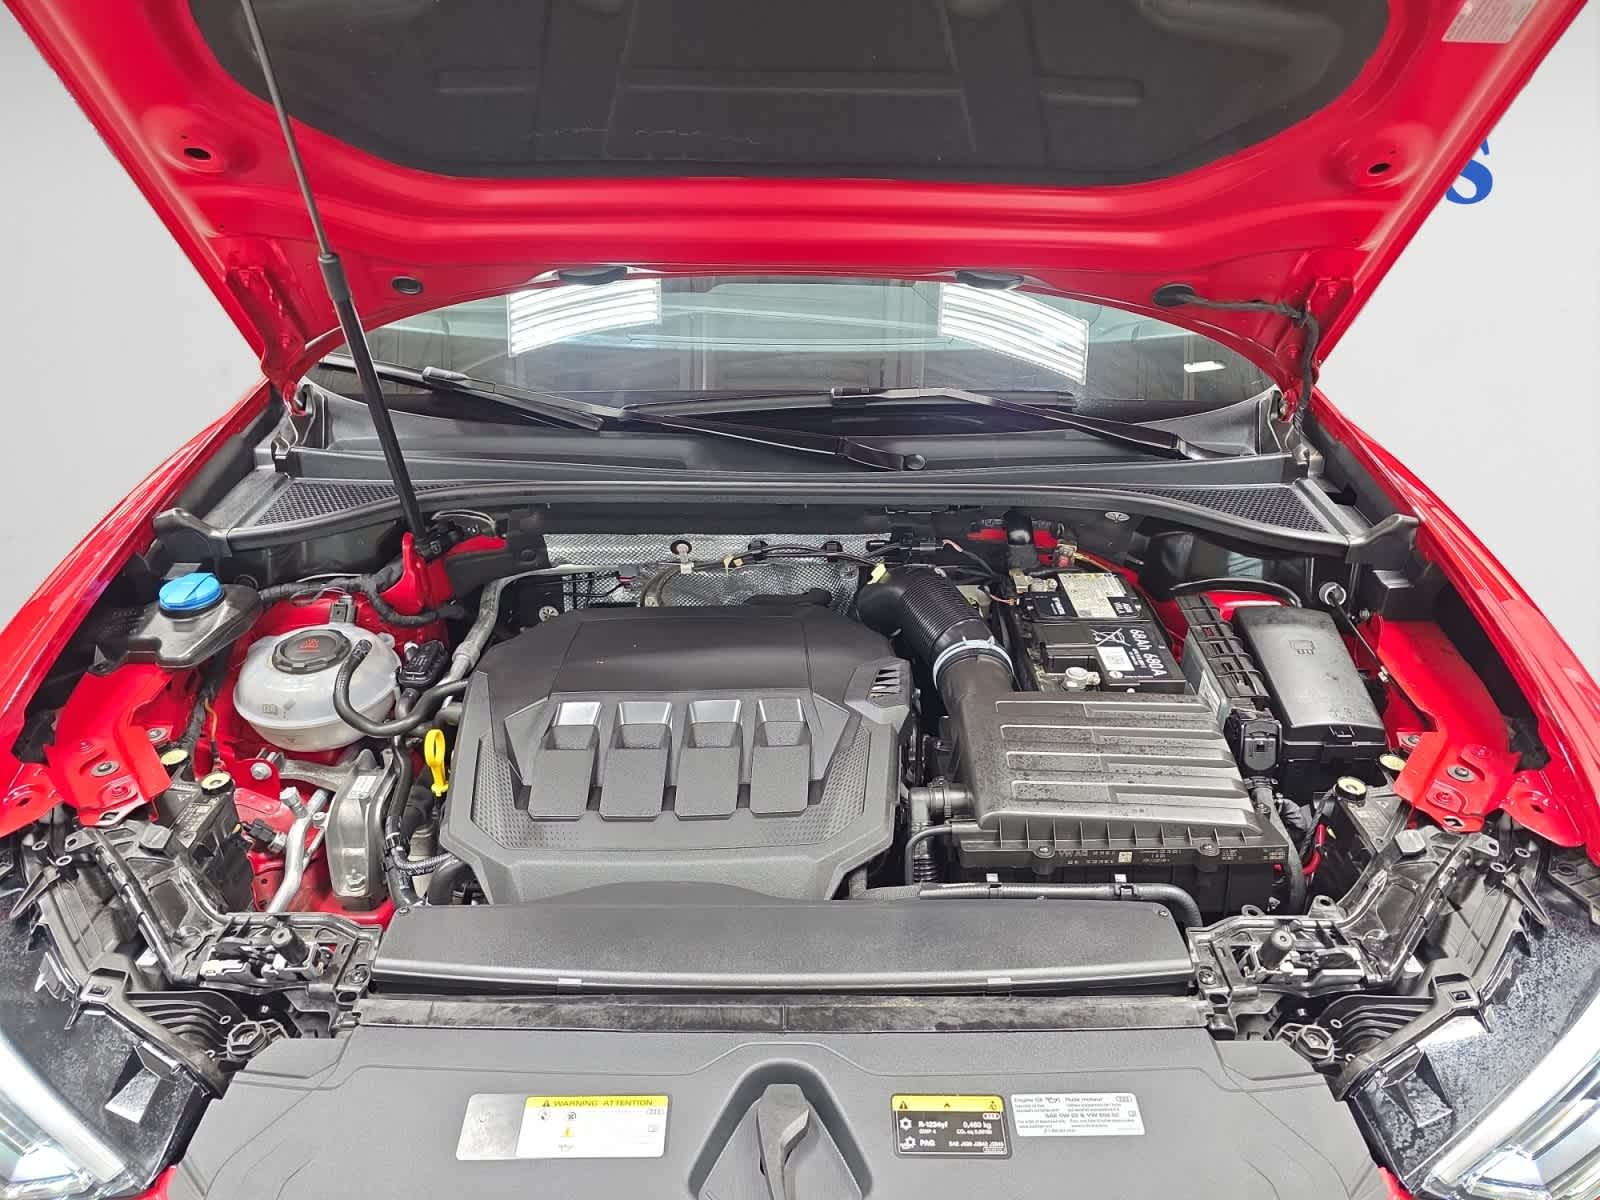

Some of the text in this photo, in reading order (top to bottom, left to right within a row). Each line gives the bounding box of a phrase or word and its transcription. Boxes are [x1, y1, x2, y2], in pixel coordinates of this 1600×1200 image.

[1129, 628, 1153, 651] 68Ah
[1143, 651, 1168, 677] 680A
[553, 1098, 654, 1107] WARNING ATTENTION
